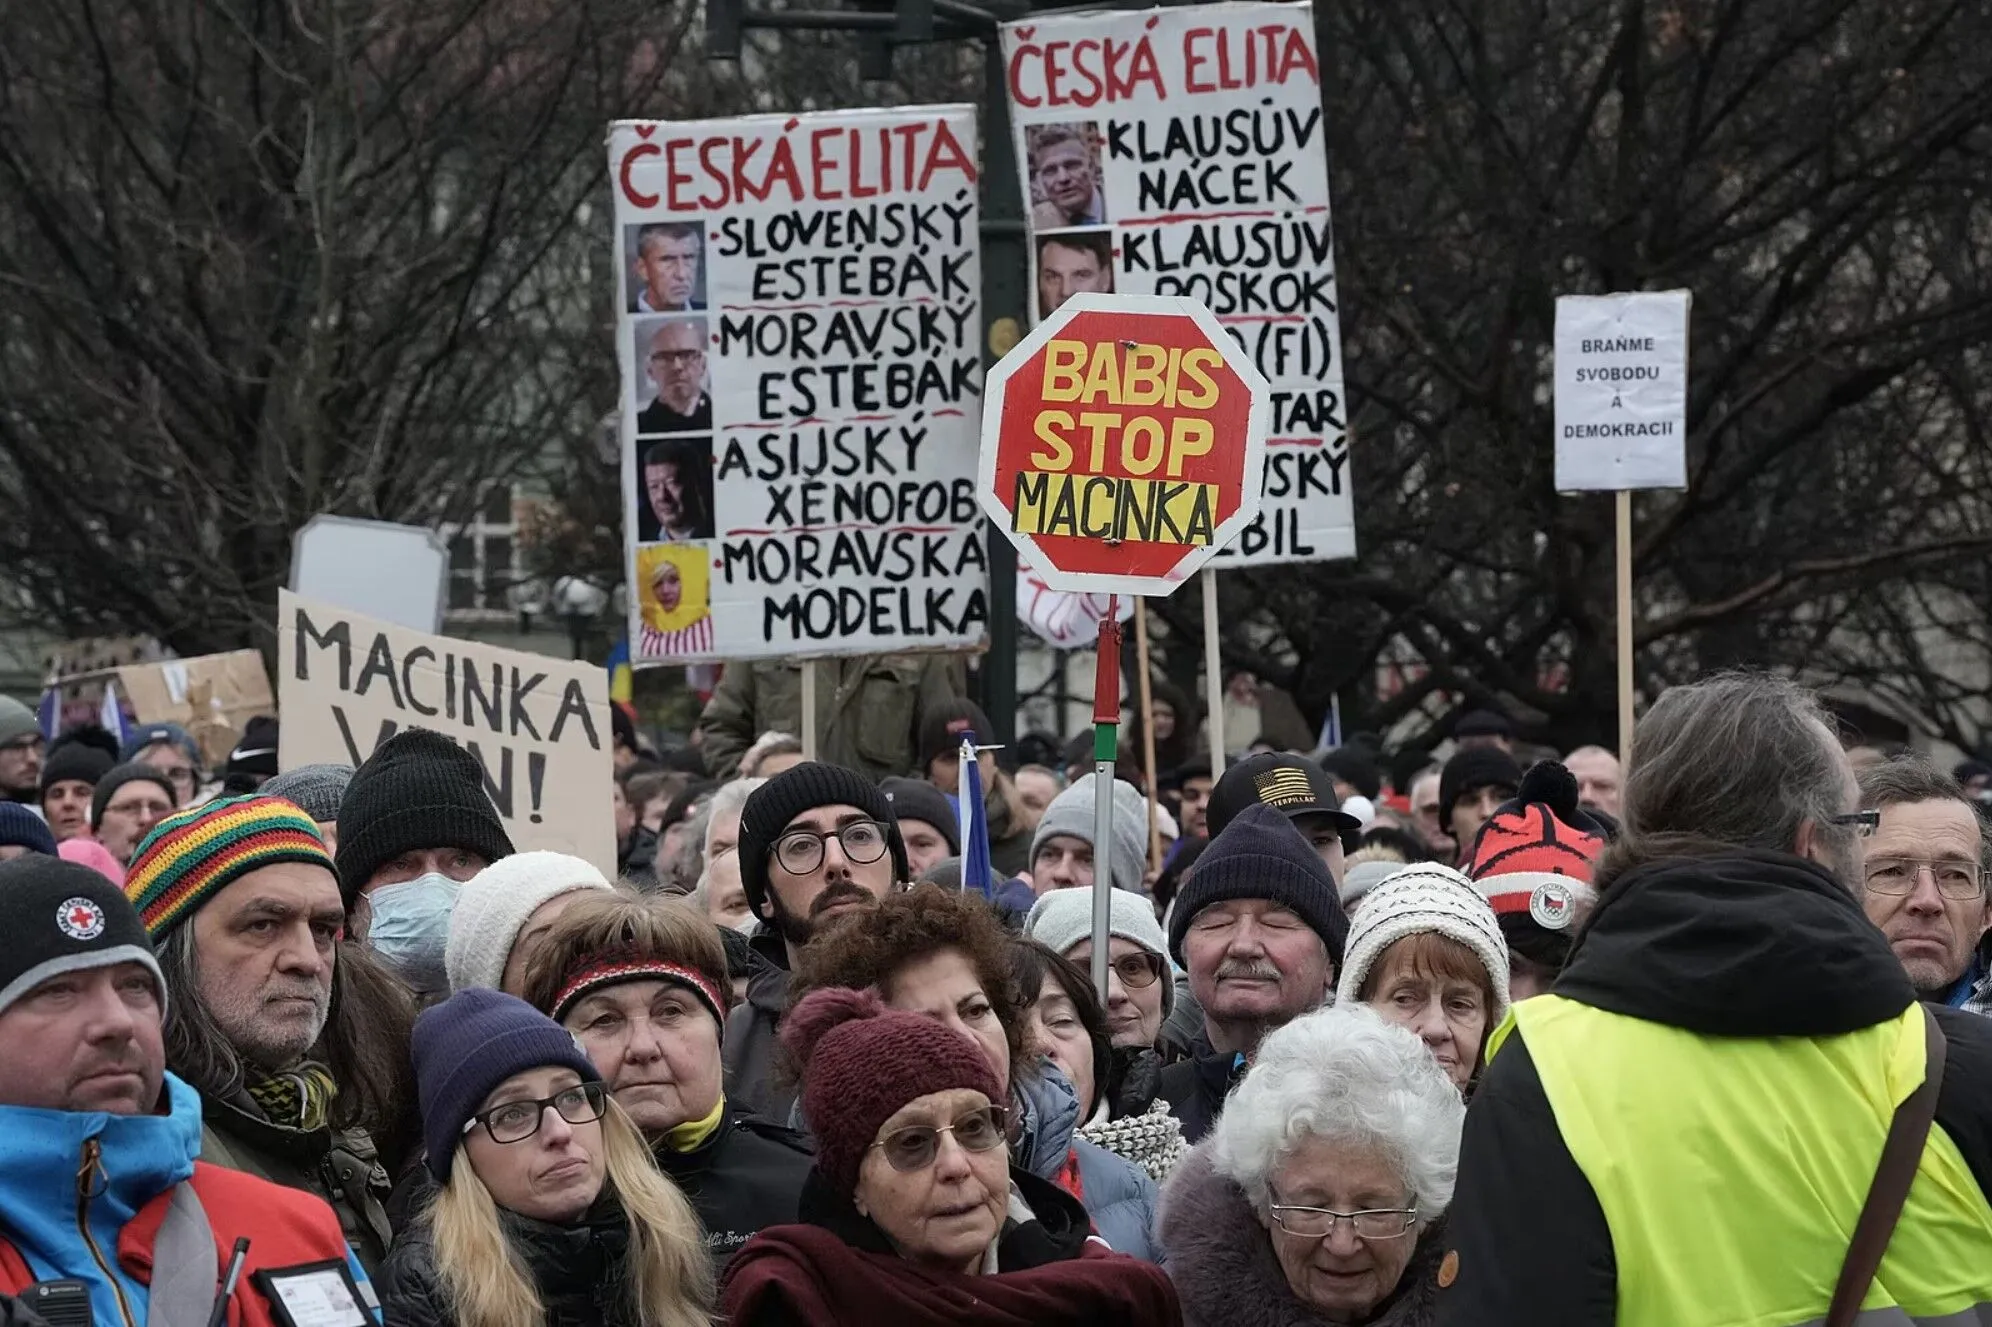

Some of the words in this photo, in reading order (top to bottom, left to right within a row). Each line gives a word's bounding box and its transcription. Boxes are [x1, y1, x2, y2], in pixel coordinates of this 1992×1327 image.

[1008, 15, 1167, 108] ČESKÁ
[1183, 24, 1319, 94] ELITA
[1108, 98, 1320, 163] KLAUSŮV
[619, 117, 805, 211] ČESKÁ
[812, 119, 977, 200] ELITA
[1138, 158, 1302, 211] NÁCEK
[718, 189, 974, 258] SLOVENSKÝ
[1122, 211, 1330, 273] KLAUSŮV
[720, 296, 976, 359] MORAVSKÝ
[1581, 334, 1655, 353] BRAŇME
[1041, 339, 1223, 409] BABIS
[1575, 366, 1660, 382] SVOBODU
[1611, 396, 1622, 408] A
[1030, 409, 1214, 477] STOP
[1269, 389, 1346, 434] TAR
[1564, 421, 1673, 439] DEMOKRACII
[718, 410, 927, 481] ASIJSKÝ
[1261, 435, 1347, 499] SKÝ
[765, 478, 977, 526] XENOFOB
[1011, 471, 1214, 546] MACINKA
[1215, 507, 1315, 557] BIL
[722, 518, 985, 585] MORAVSKÁ
[764, 587, 988, 642] MODELKA
[295, 607, 600, 750] MACINKA
[331, 705, 546, 825] VN!
